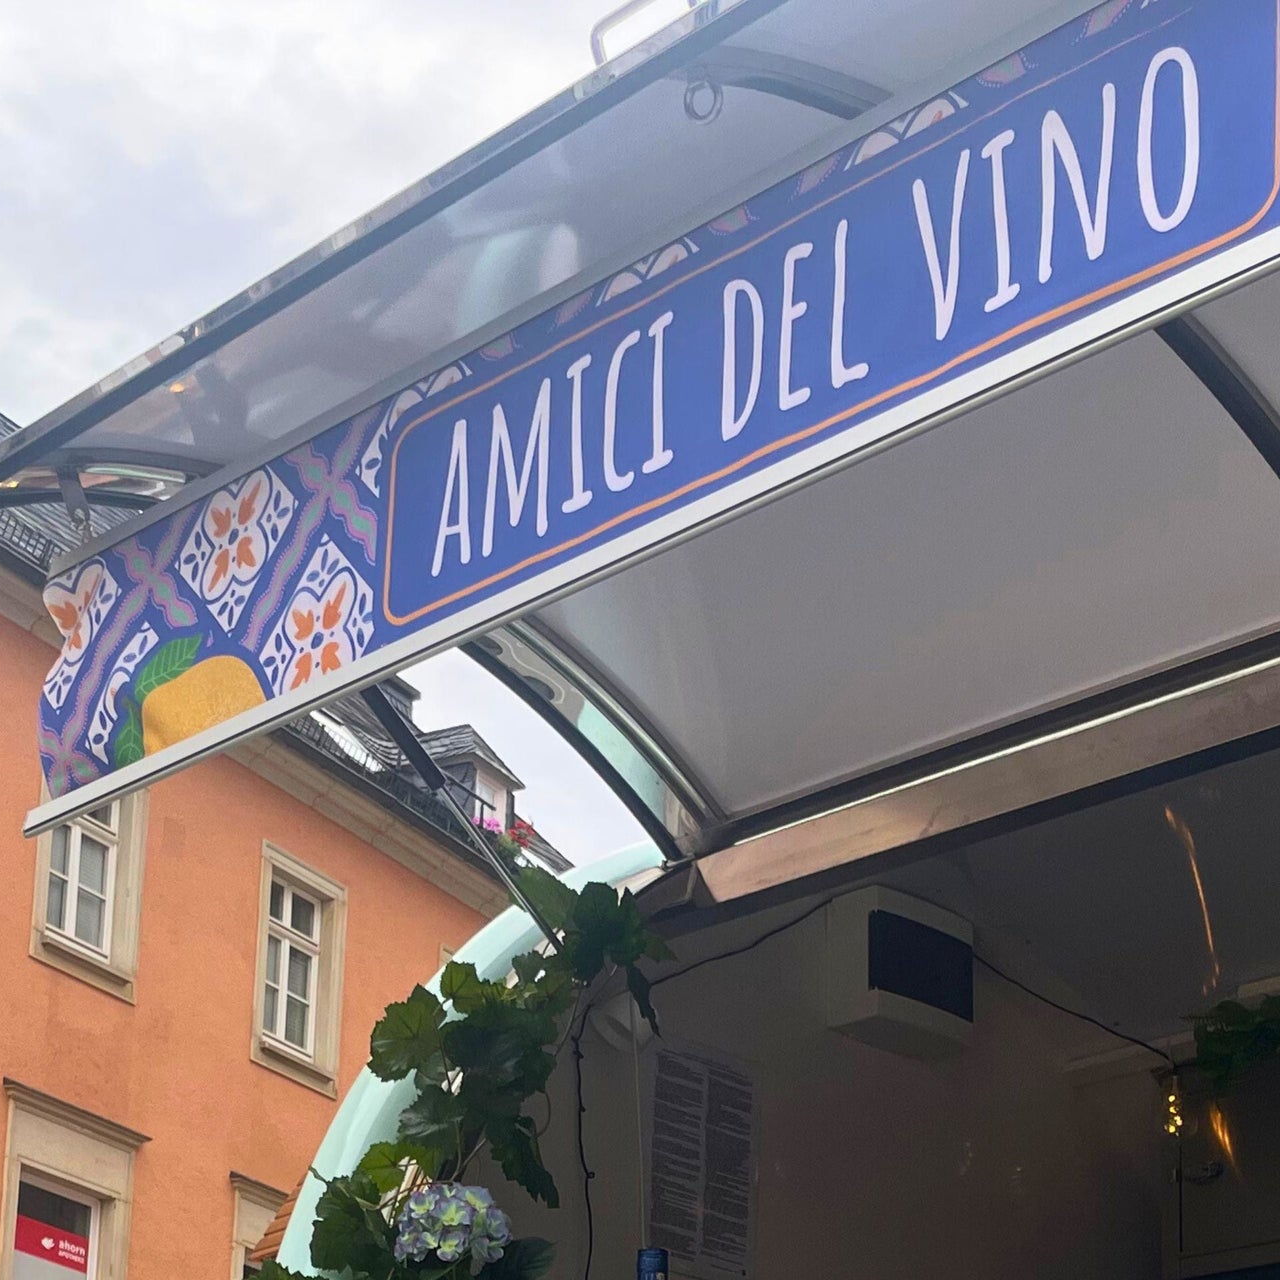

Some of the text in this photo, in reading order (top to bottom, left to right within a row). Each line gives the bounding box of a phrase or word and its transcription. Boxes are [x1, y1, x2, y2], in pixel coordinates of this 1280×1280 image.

[431, 46, 1200, 579] AMICI DEL VINO
[59, 1240, 85, 1257] ahorn
